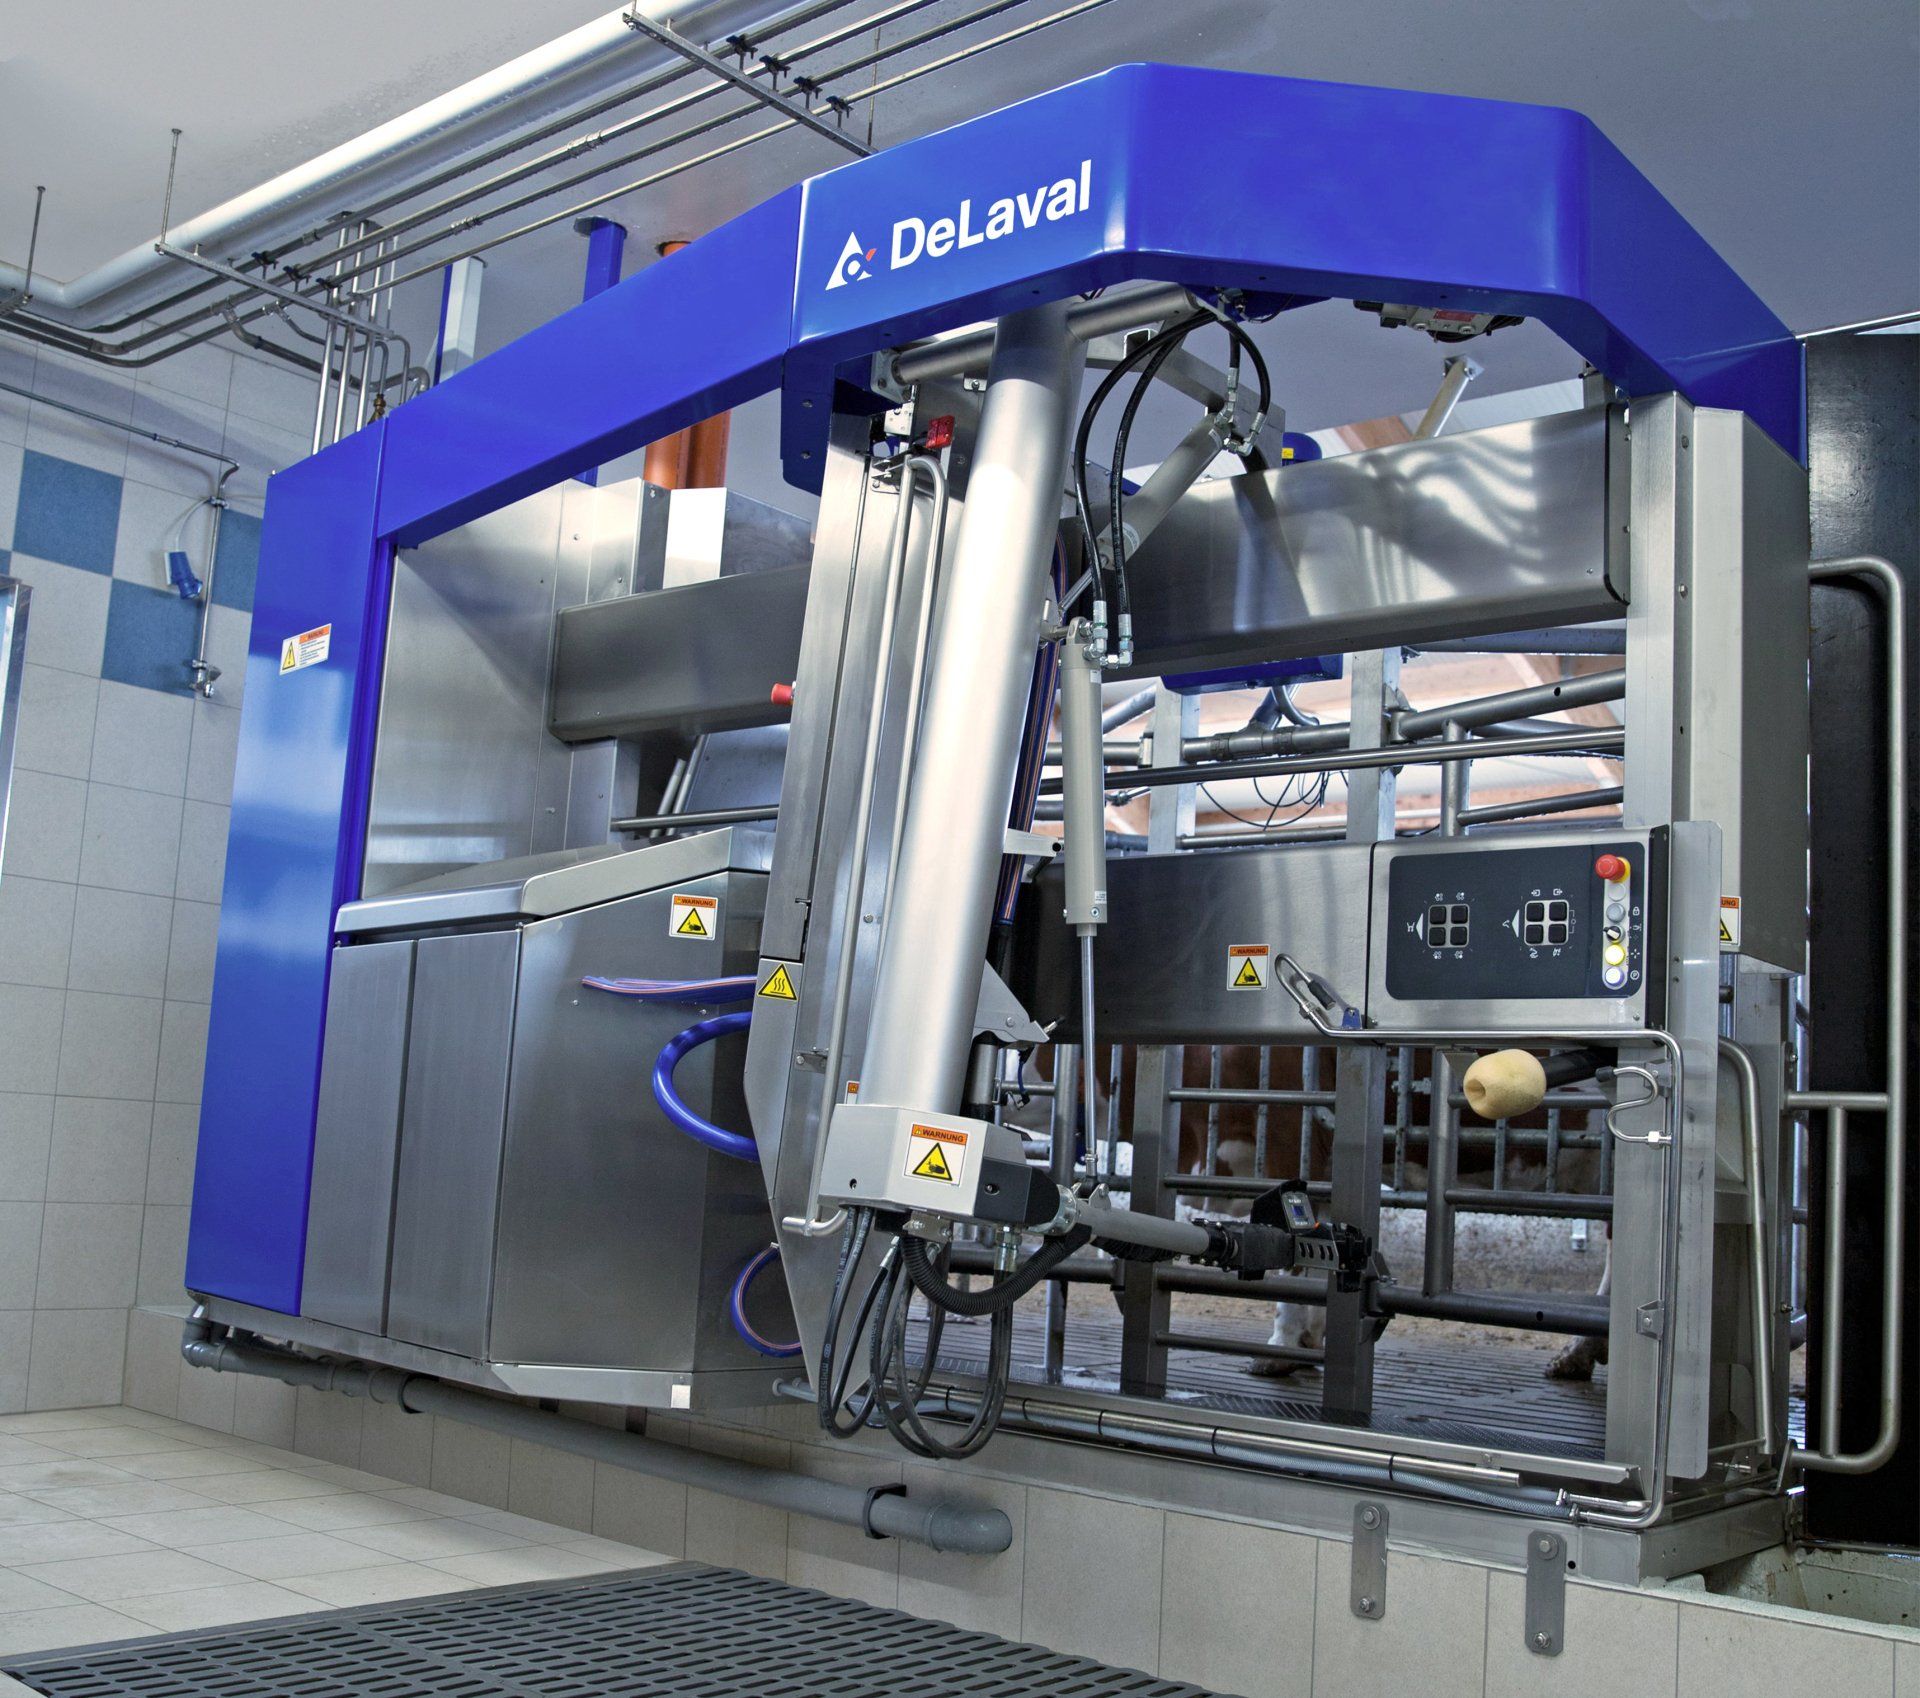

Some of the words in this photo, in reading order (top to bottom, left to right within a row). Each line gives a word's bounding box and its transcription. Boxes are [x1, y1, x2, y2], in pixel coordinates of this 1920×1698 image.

[890, 159, 1091, 270] DeLaval
[681, 898, 713, 906] WARNUNG
[1237, 947, 1266, 955] WARNUNG
[922, 1129, 964, 1142] WARNUNG
